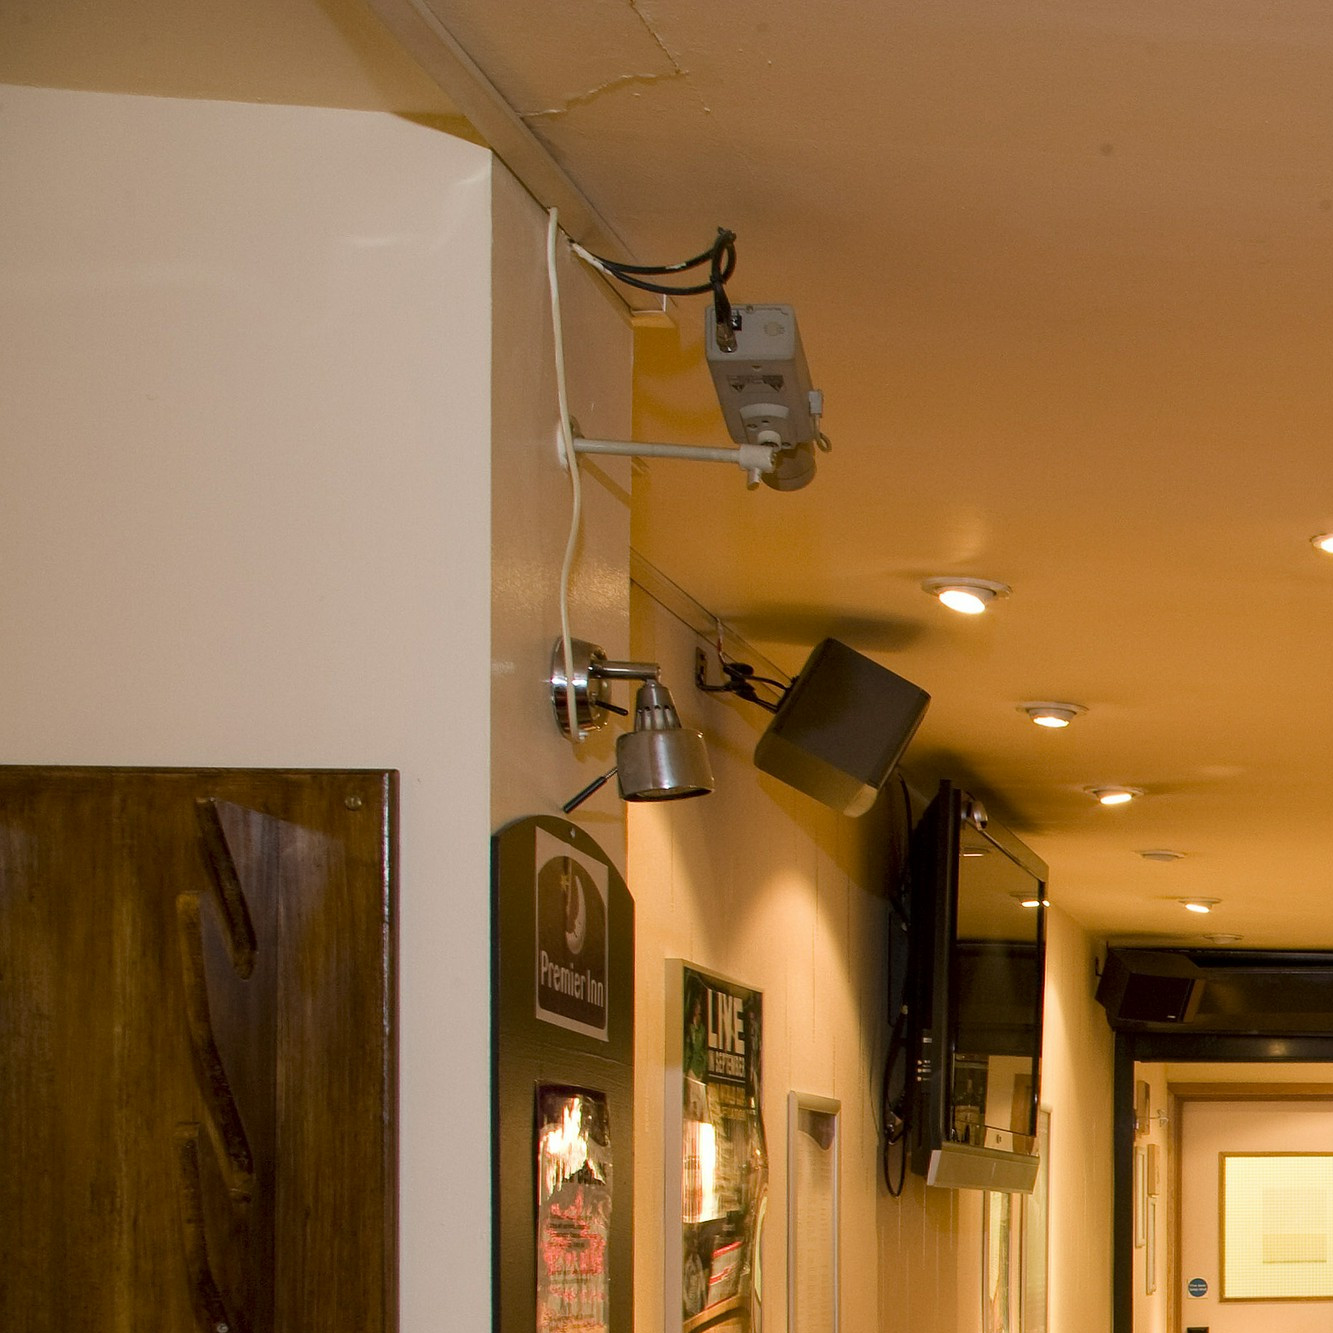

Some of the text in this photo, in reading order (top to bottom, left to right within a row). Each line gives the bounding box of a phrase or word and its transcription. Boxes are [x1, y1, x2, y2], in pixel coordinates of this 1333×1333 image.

[541, 950, 605, 1008] Premier Inn
[707, 988, 745, 1056] LIVE
